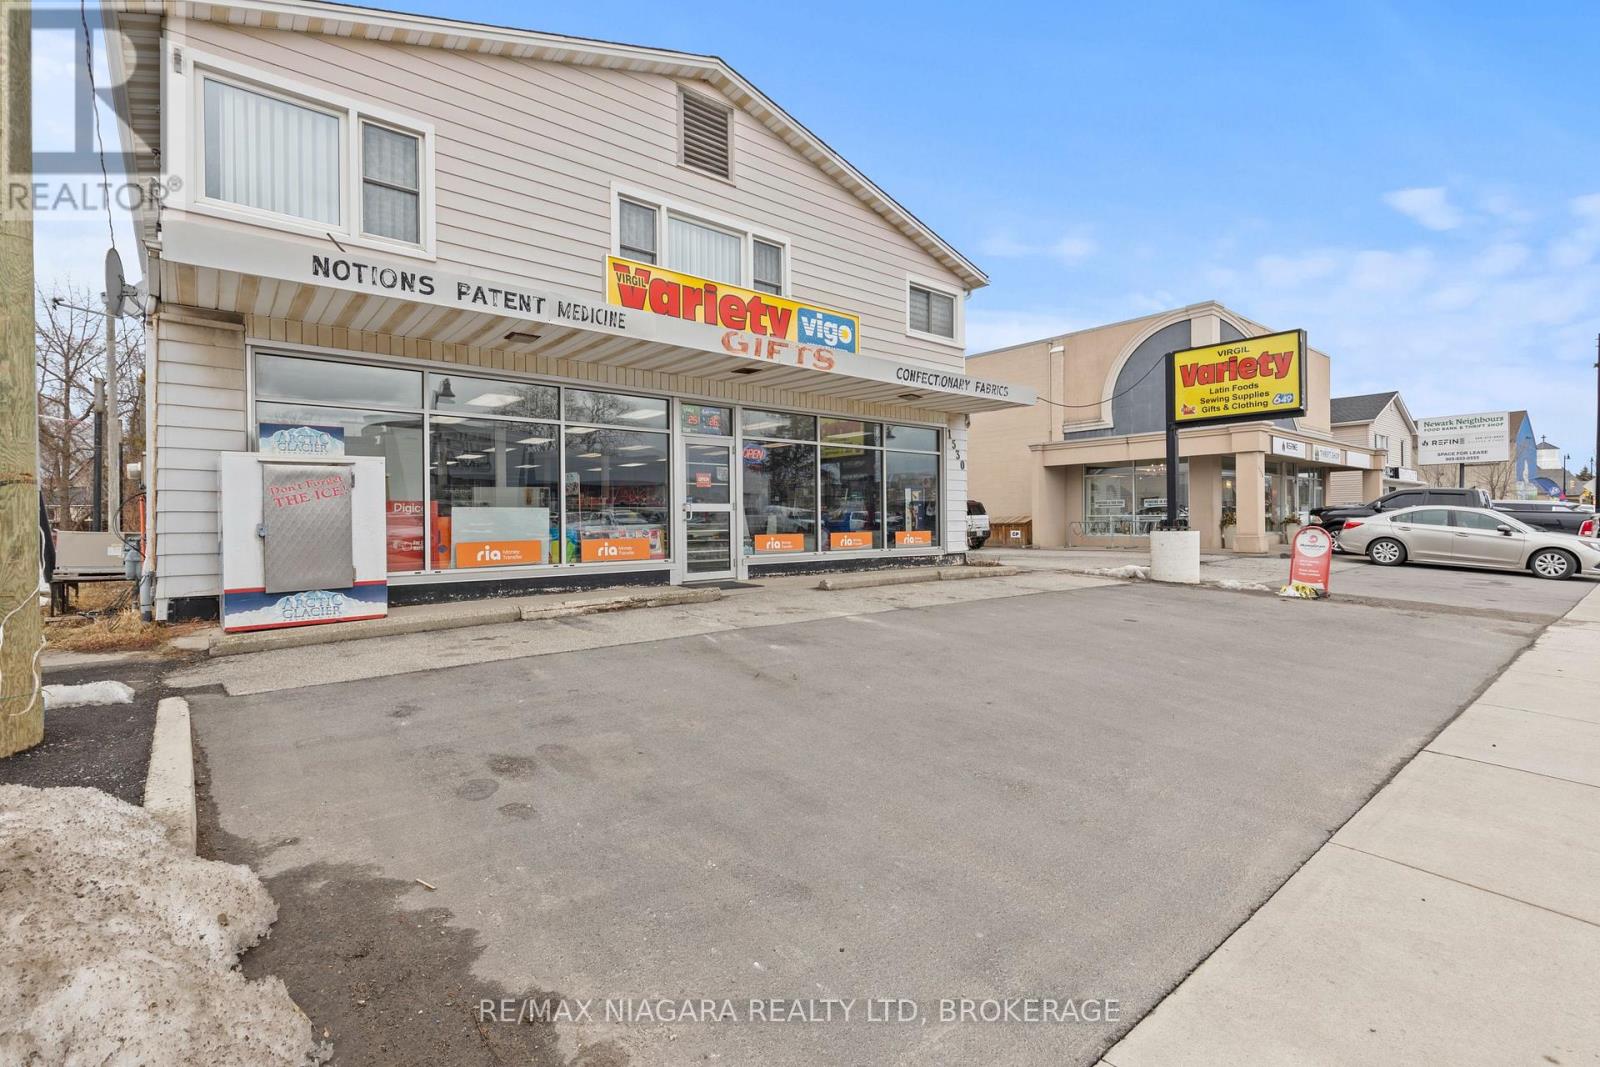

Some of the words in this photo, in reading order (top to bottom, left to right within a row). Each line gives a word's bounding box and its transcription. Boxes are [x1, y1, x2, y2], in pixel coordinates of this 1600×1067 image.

[616, 271, 647, 288] VIRGIL
[312, 254, 435, 296] NOTIONS
[457, 281, 546, 315] PATENT
[558, 300, 626, 329] MEDICINE
[801, 313, 852, 345] vigo
[721, 331, 835, 371] GIFTS
[1217, 346, 1249, 357] VIRGIL
[1180, 351, 1294, 388] Variety
[975, 381, 1009, 397] FABRICS
[1209, 387, 1230, 395] Latin
[1232, 383, 1259, 392] Foods
[1200, 395, 1230, 404] Sewing
[1232, 391, 1270, 401] Supplies
[1232, 400, 1269, 410] Clothing
[1456, 416, 1504, 425] Neighbours
[277, 442, 329, 453] GLACIER
[1431, 438, 1465, 446] REFINE
[270, 483, 303, 495] Don't
[305, 475, 342, 488] Forget
[274, 492, 311, 507] THE
[313, 485, 348, 500] ICE!
[766, 537, 781, 549] ria
[840, 535, 853, 546] ria
[903, 534, 914, 544] ria
[477, 545, 501, 561] ria
[598, 542, 618, 557] ria
[282, 593, 343, 610] ARCTIC
[282, 605, 342, 618] GLACIER
